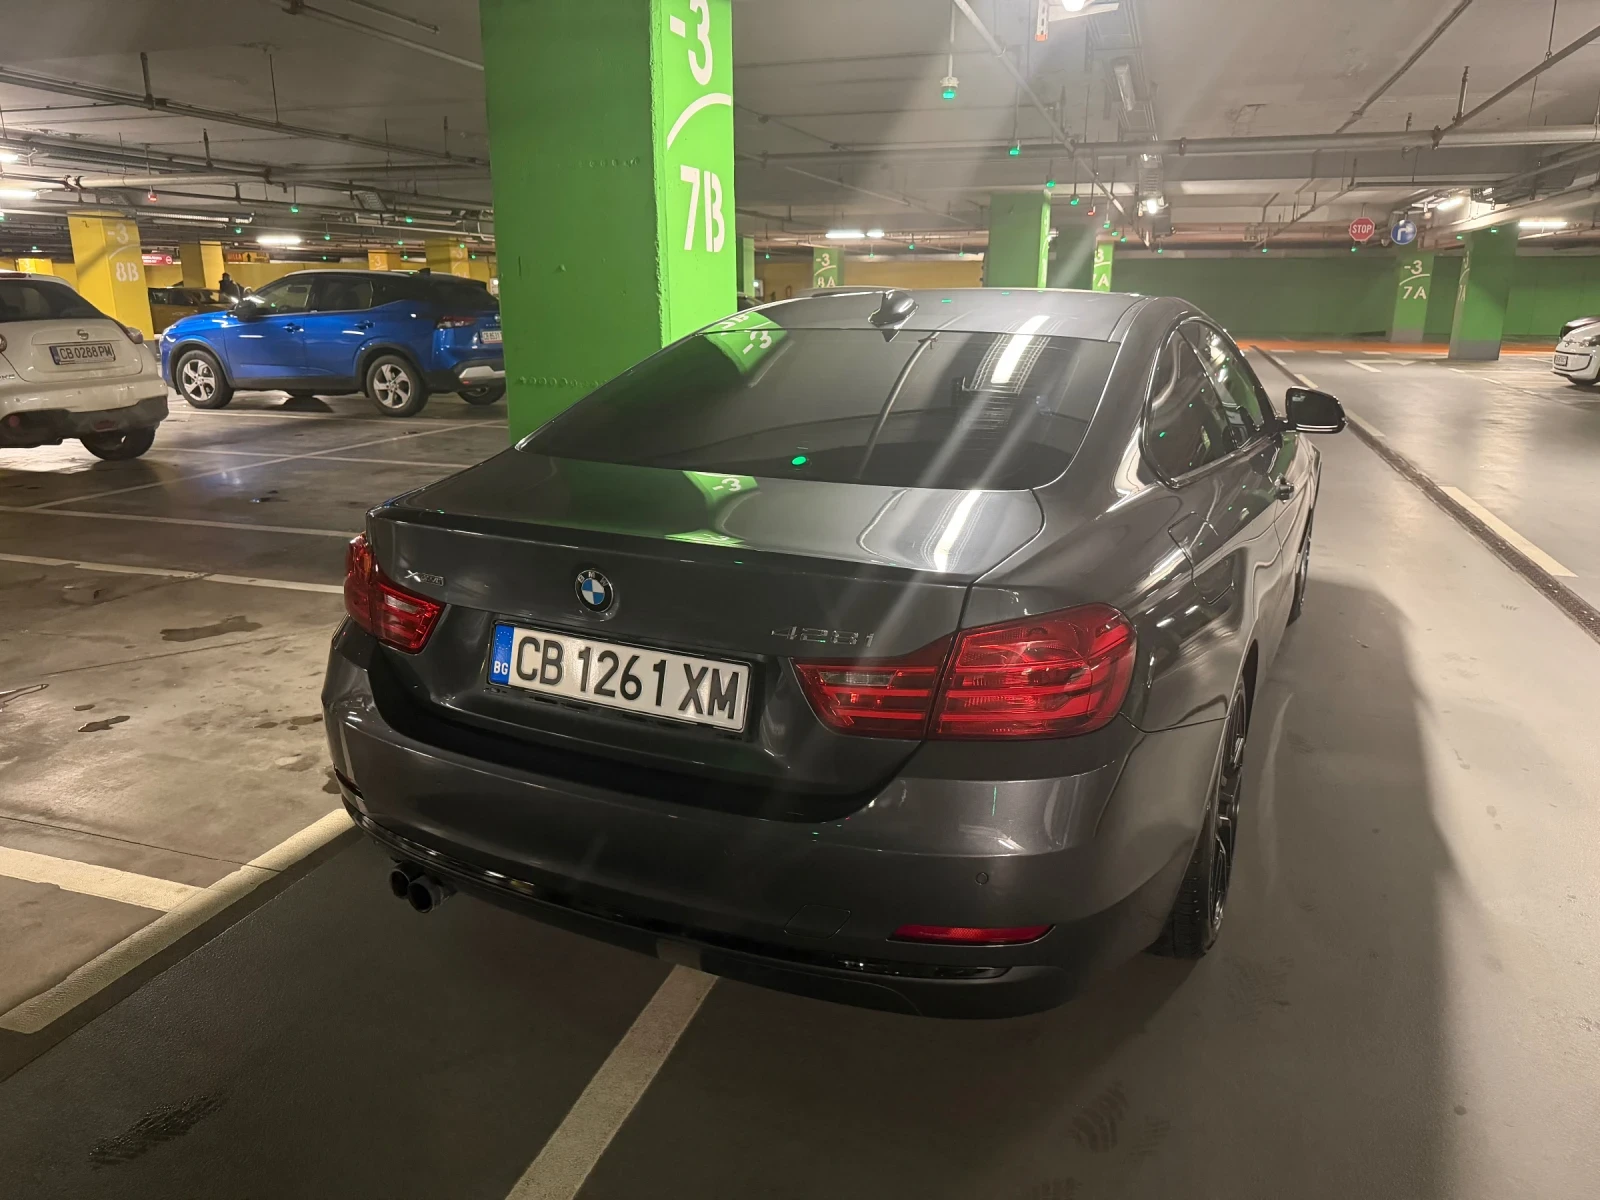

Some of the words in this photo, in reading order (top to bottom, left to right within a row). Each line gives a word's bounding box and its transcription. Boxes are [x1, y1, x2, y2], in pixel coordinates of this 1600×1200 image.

[669, 0, 713, 86] -3
[680, 164, 726, 253] 7B
[107, 223, 129, 244] -3
[1352, 224, 1372, 234] STOP
[816, 253, 830, 267] -3
[1404, 260, 1423, 274] -3
[116, 262, 139, 282] 8B
[60, 347, 74, 359] CB
[76, 346, 98, 359] 0288
[99, 345, 112, 357] PM
[577, 571, 609, 587] BMW
[493, 660, 509, 675] BG
[516, 636, 564, 686] CB
[577, 646, 667, 707] 1261
[678, 663, 740, 720] XM
